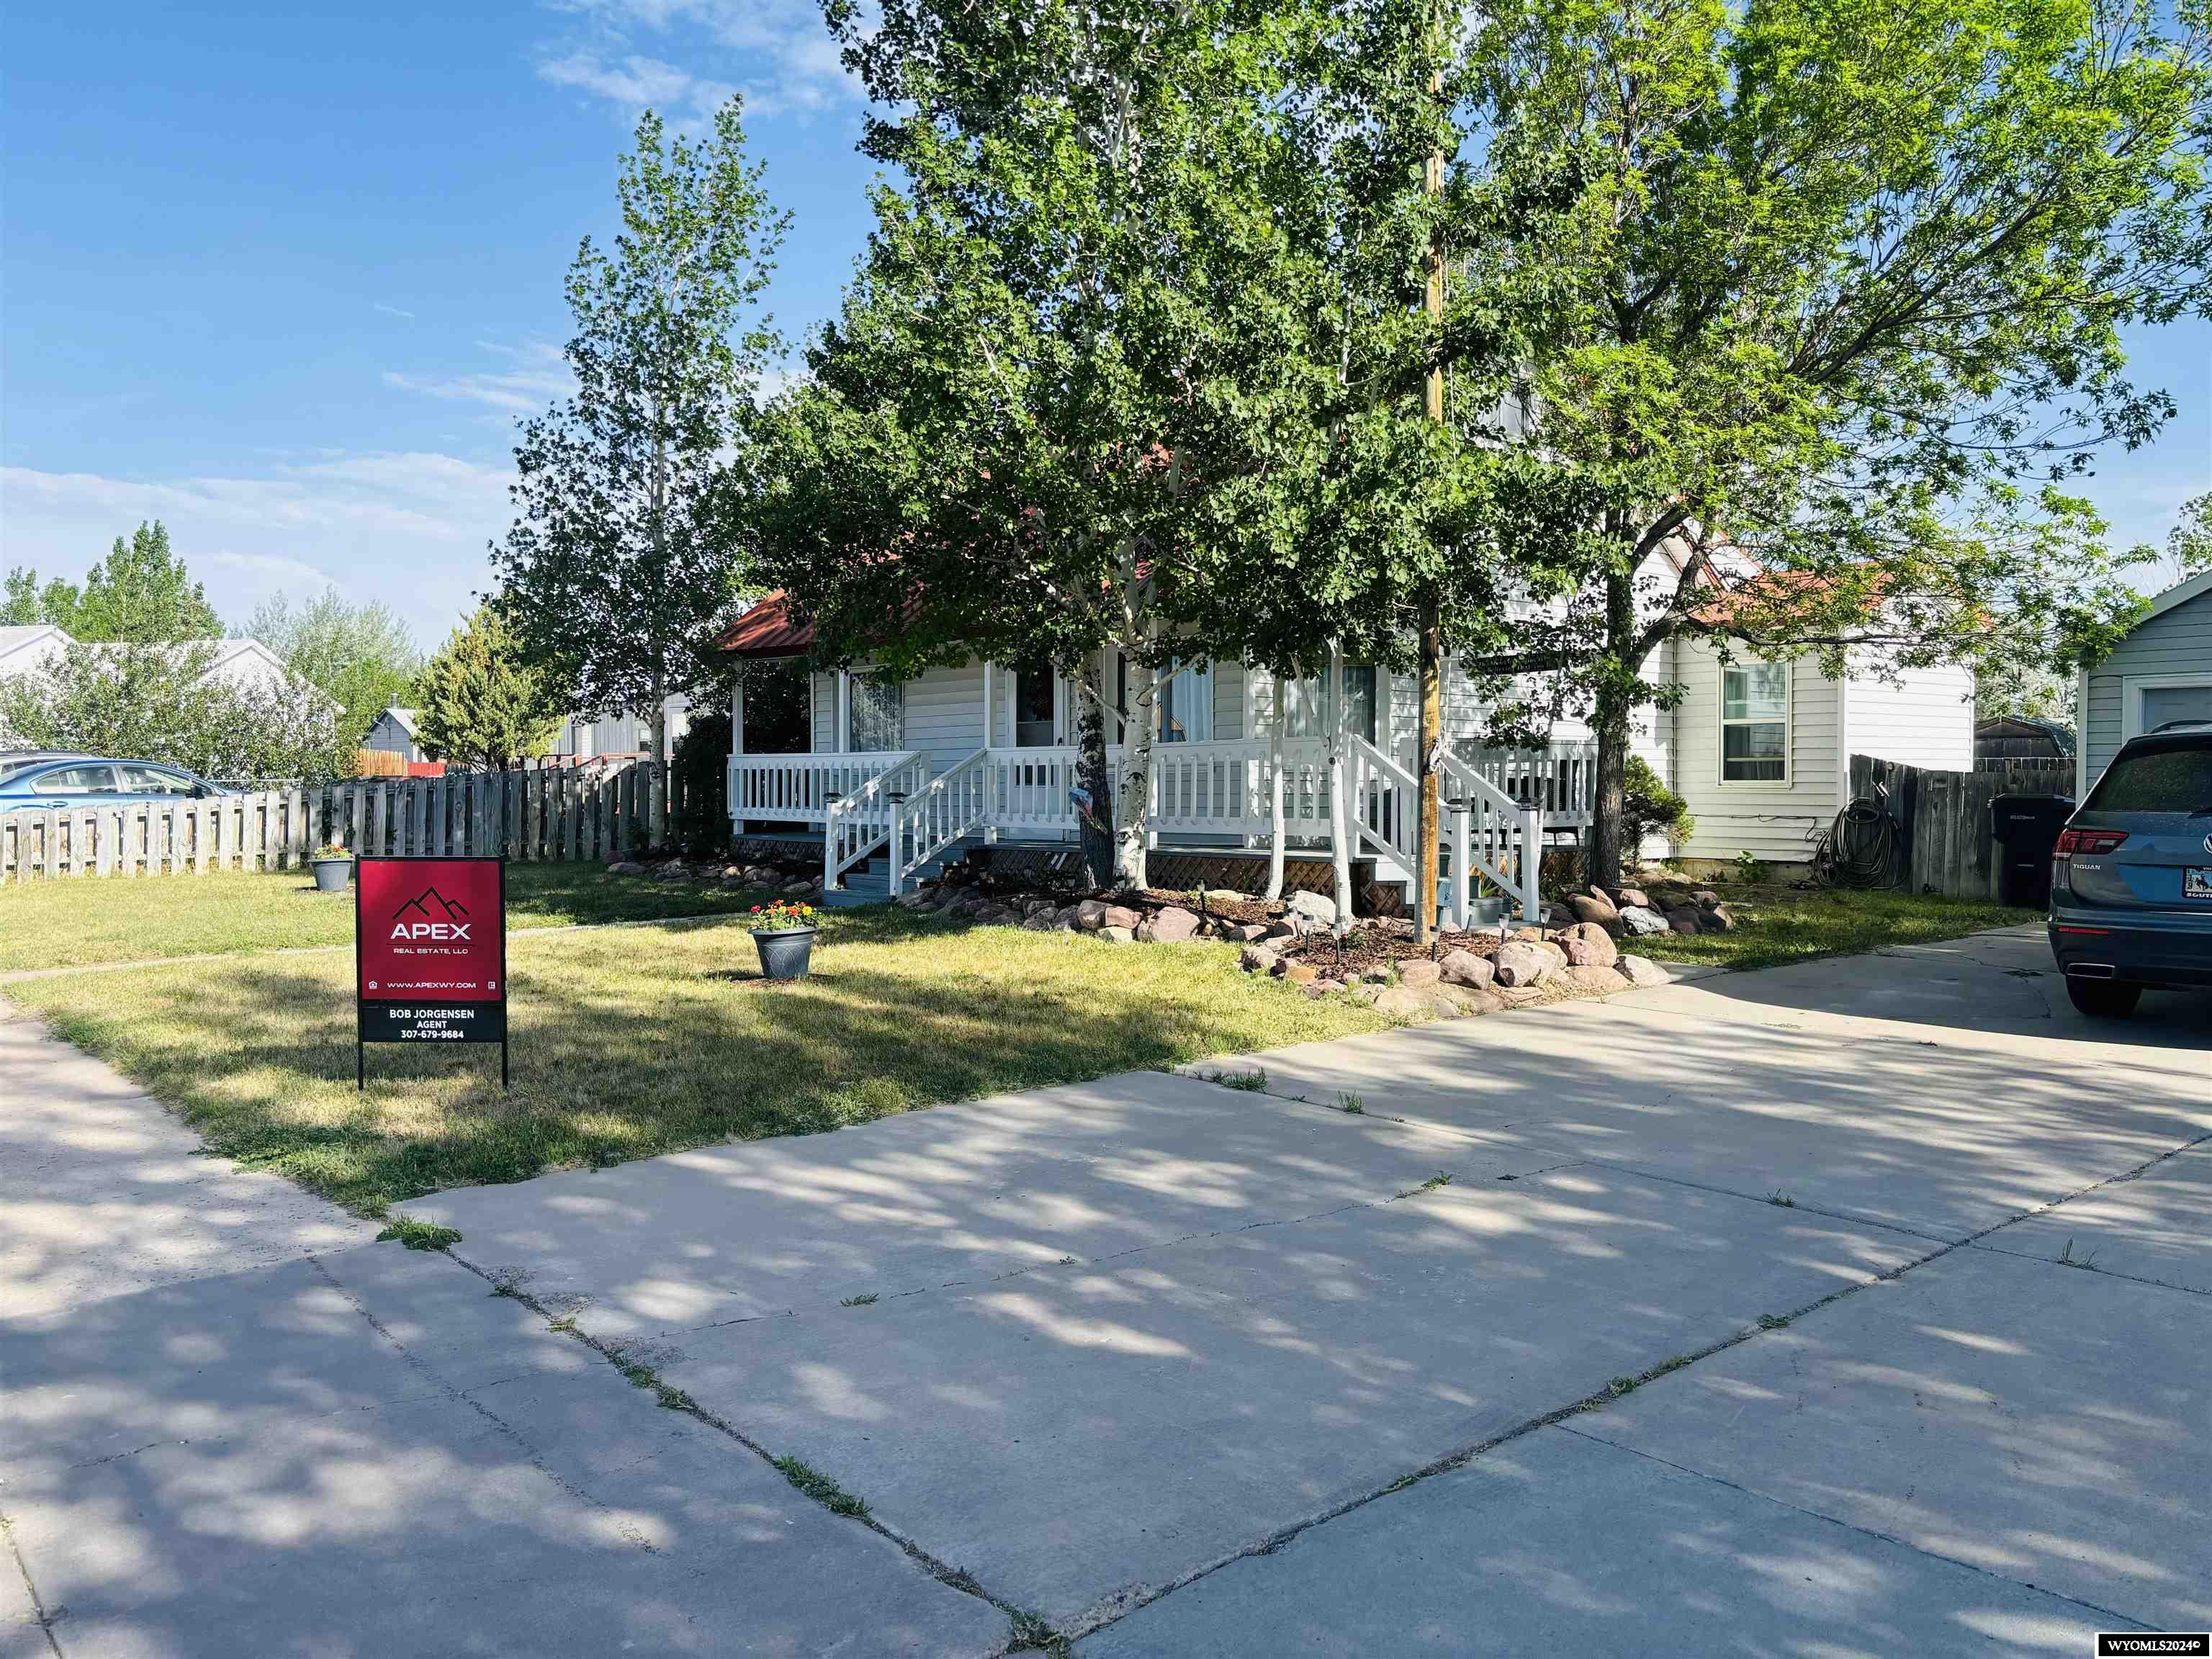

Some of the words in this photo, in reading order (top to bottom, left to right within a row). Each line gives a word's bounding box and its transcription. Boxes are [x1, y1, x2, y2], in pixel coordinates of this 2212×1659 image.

[390, 923, 472, 940] APEX
[390, 1010, 411, 1019] BOB
[413, 1010, 475, 1019] JORGENSEN
[416, 1020, 448, 1029] AGENT
[400, 1030, 464, 1039] 307-679-9684
